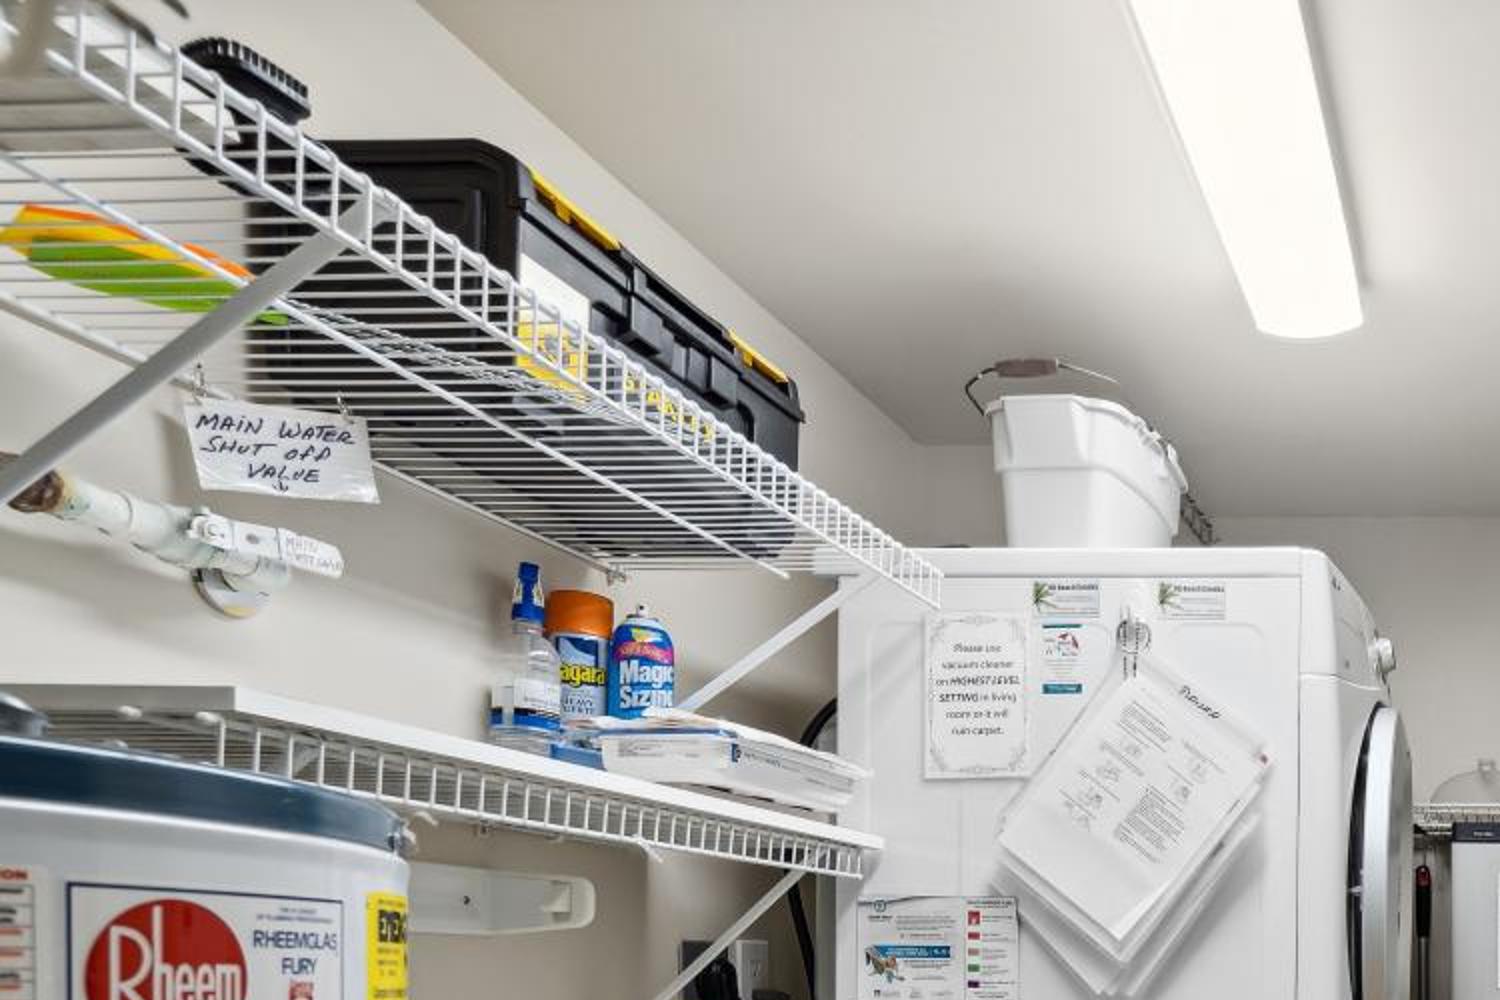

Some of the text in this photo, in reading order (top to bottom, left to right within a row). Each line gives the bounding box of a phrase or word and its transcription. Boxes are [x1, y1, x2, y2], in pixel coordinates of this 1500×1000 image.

[195, 413, 356, 445] MAIN WATER
[200, 435, 277, 457] SHUT
[953, 642, 1002, 653] Please use
[941, 659, 1013, 670] vacuum cleaner
[560, 662, 606, 686] agara
[936, 675, 1020, 686] on HIGHEST LEVEL
[939, 693, 978, 703] SETTING
[991, 693, 1017, 703] living
[946, 711, 971, 719] room
[993, 709, 1009, 718] will
[281, 957, 318, 975] FURY
